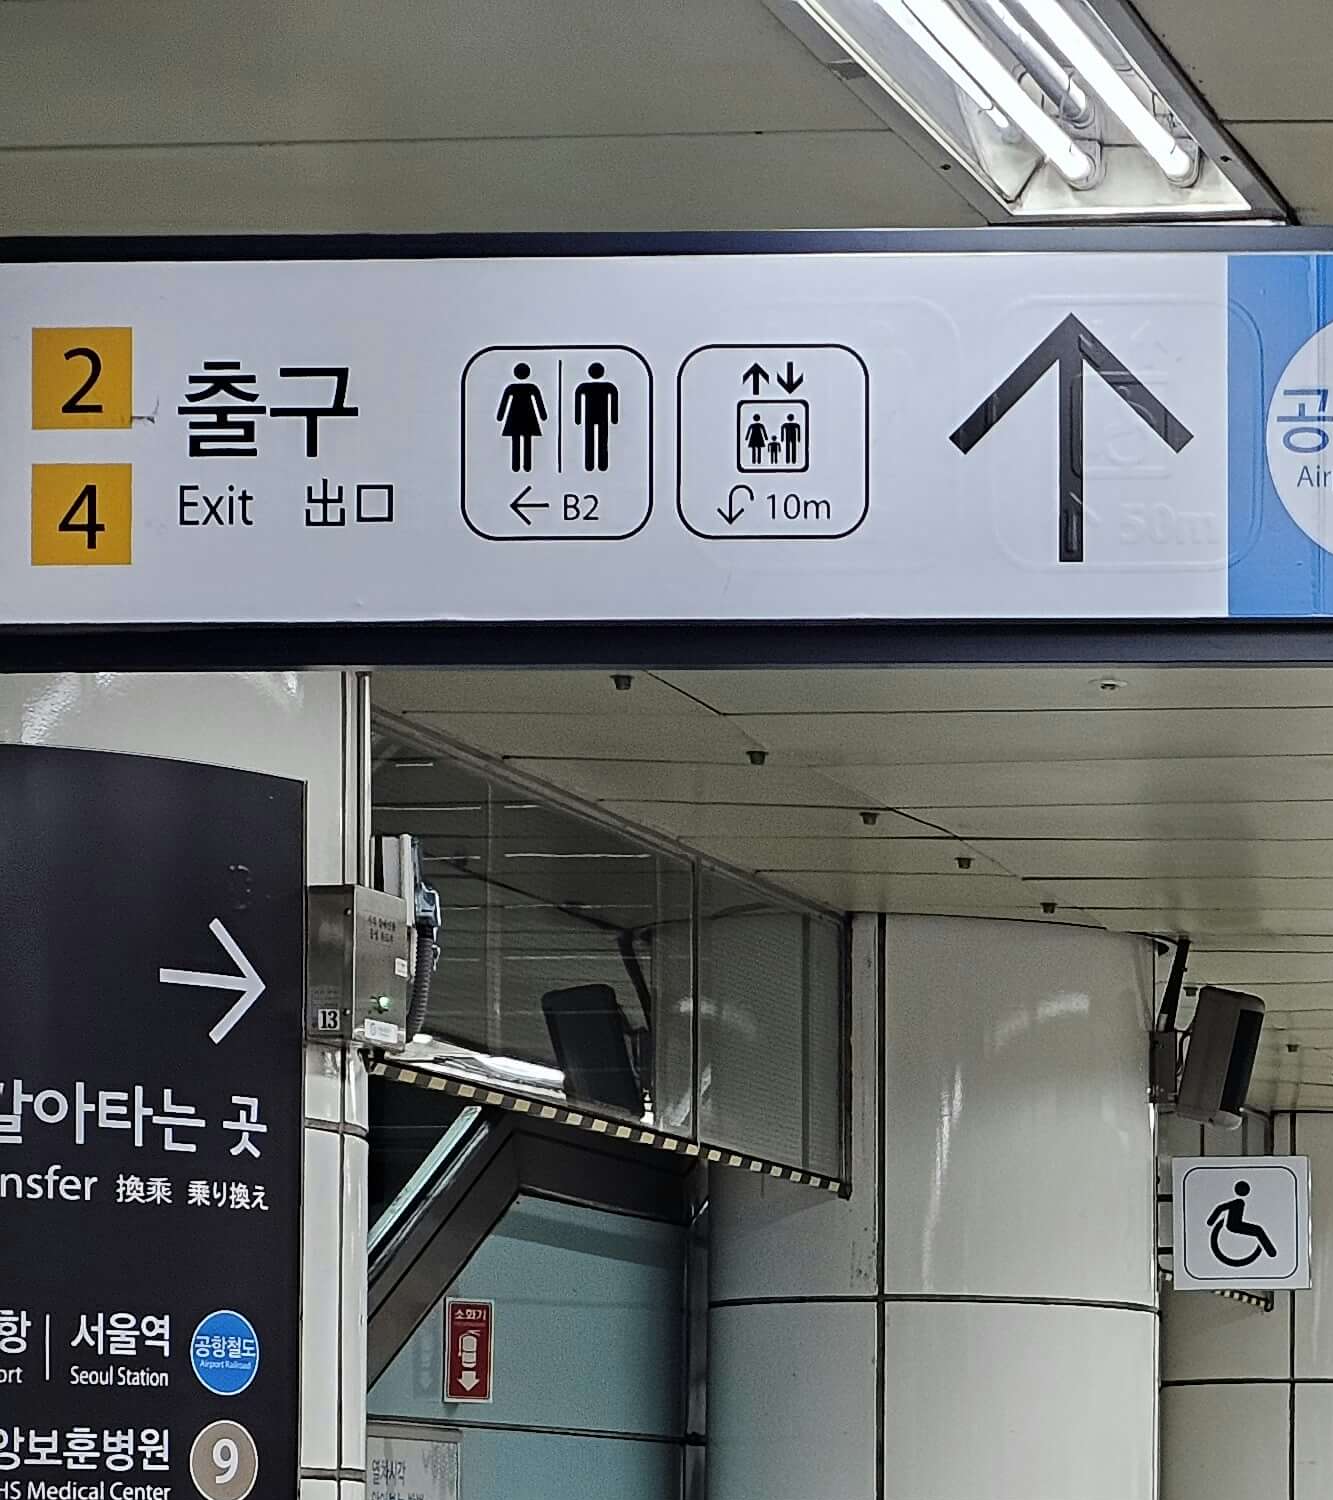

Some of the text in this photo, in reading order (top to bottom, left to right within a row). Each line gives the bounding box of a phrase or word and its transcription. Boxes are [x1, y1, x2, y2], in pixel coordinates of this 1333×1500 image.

[61, 347, 103, 414] 2
[177, 361, 359, 458] 출구
[58, 484, 106, 550] 4
[179, 478, 394, 527] Exit 出口
[563, 493, 599, 521] B2
[766, 493, 831, 520] 10m
[321, 1010, 338, 1029] 13
[222, 1095, 268, 1159] 곳
[454, 1309, 487, 1321] 소화기
[70, 1312, 170, 1358] 서울역
[194, 1335, 257, 1359] 공항철도
[70, 1365, 114, 1386] Seoul
[117, 1366, 169, 1387] Station
[211, 1437, 240, 1485] 9
[27, 1480, 105, 1500] Medical
